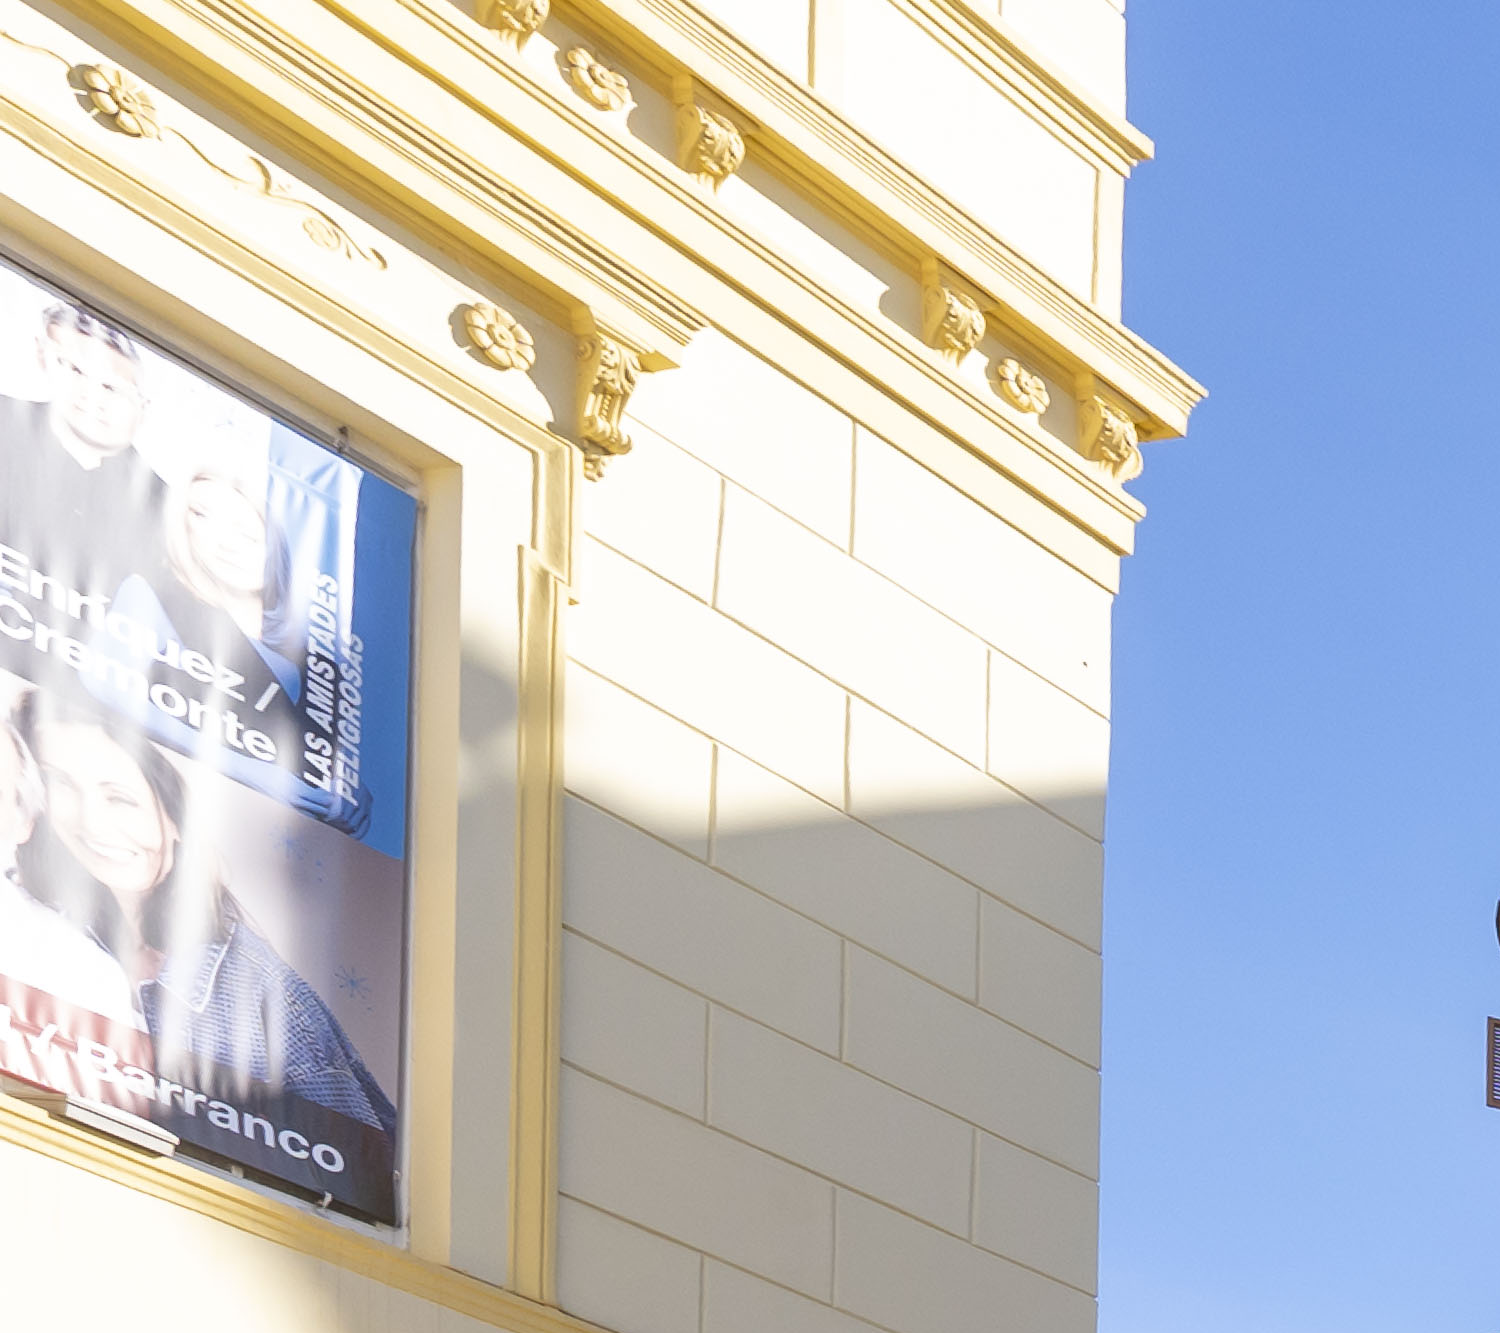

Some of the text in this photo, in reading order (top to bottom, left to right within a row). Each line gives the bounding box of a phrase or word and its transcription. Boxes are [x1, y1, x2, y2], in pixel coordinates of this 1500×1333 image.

[0, 596, 278, 762] Cremonte
[304, 572, 338, 793] LAS AMISTADES
[337, 632, 365, 806] PELIGROSAS
[77, 1036, 345, 1173] Barranco
